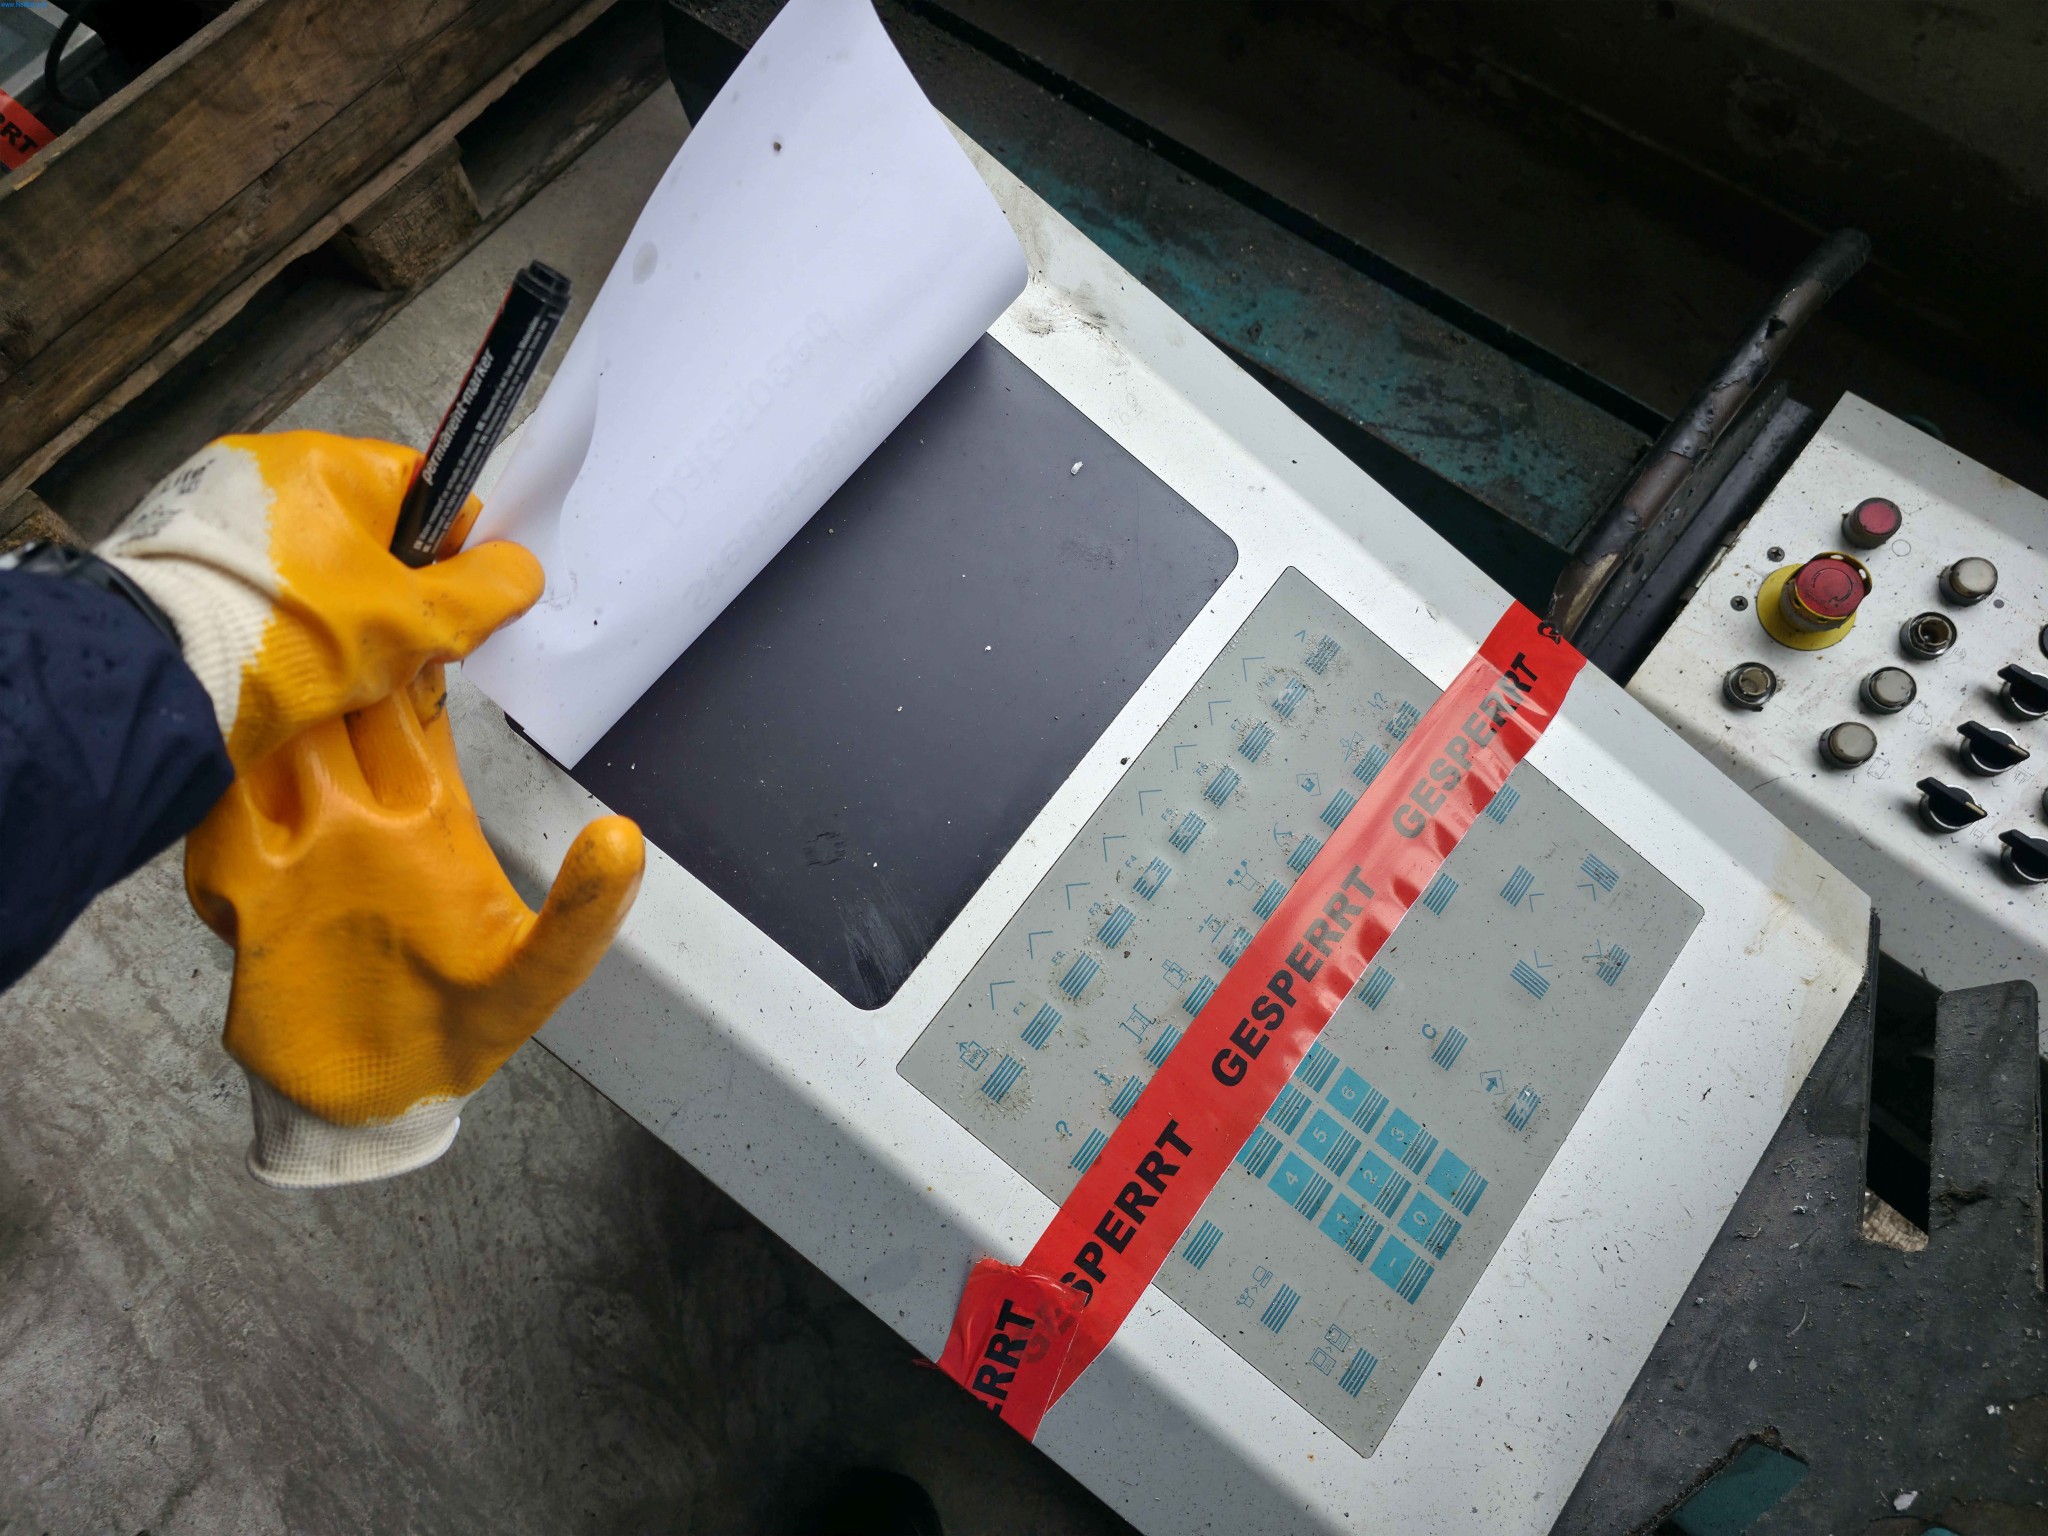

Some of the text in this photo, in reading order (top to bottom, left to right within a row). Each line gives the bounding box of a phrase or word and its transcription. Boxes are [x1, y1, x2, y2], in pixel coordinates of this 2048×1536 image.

[421, 400, 468, 486] permanent
[460, 345, 495, 407] marker
[1392, 651, 1538, 839] GESPERRT
[1124, 854, 1137, 868] F4
[1088, 902, 1102, 916] F3
[1051, 951, 1066, 967] F2
[1211, 864, 1376, 1087] GESPERRT
[1013, 1001, 1026, 1016] F1
[1341, 1085, 1356, 1100] 6
[1312, 1127, 1327, 1143] 5
[1391, 1127, 1405, 1142] 3
[1285, 1170, 1299, 1186] 4
[1363, 1169, 1378, 1185] 2
[1022, 1119, 1193, 1364] SPERRT
